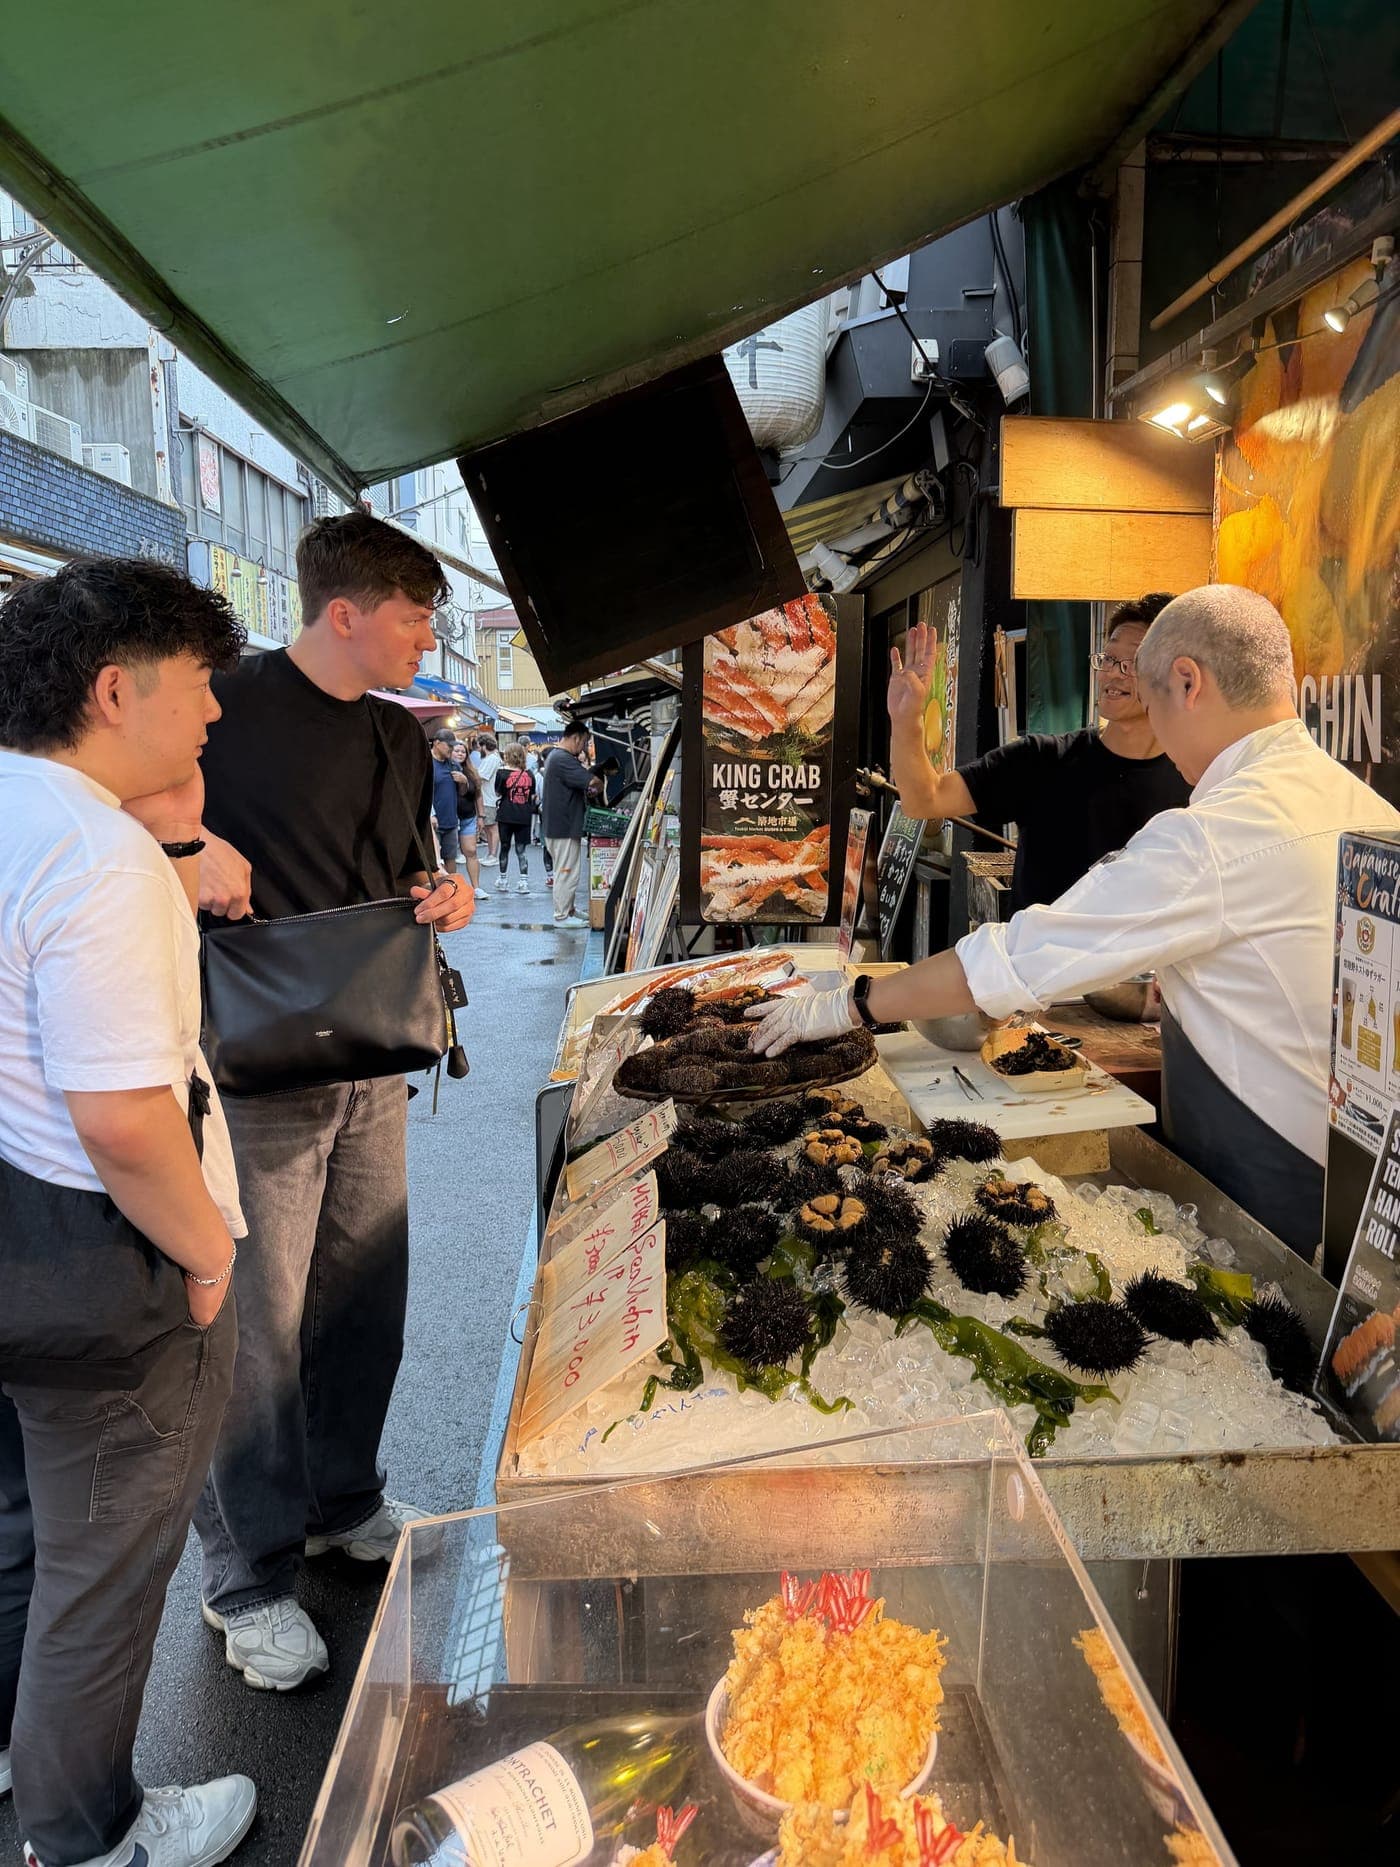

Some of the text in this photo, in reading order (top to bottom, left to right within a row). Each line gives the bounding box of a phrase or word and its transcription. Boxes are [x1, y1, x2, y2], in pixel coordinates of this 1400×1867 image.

[1293, 674, 1382, 763] CHIN
[712, 764, 821, 790] KING CRAB
[718, 789, 814, 812] 蟹センター
[1343, 845, 1400, 881] Japanese
[1374, 1187, 1400, 1229] HAN
[1365, 1217, 1398, 1261] ROLL
